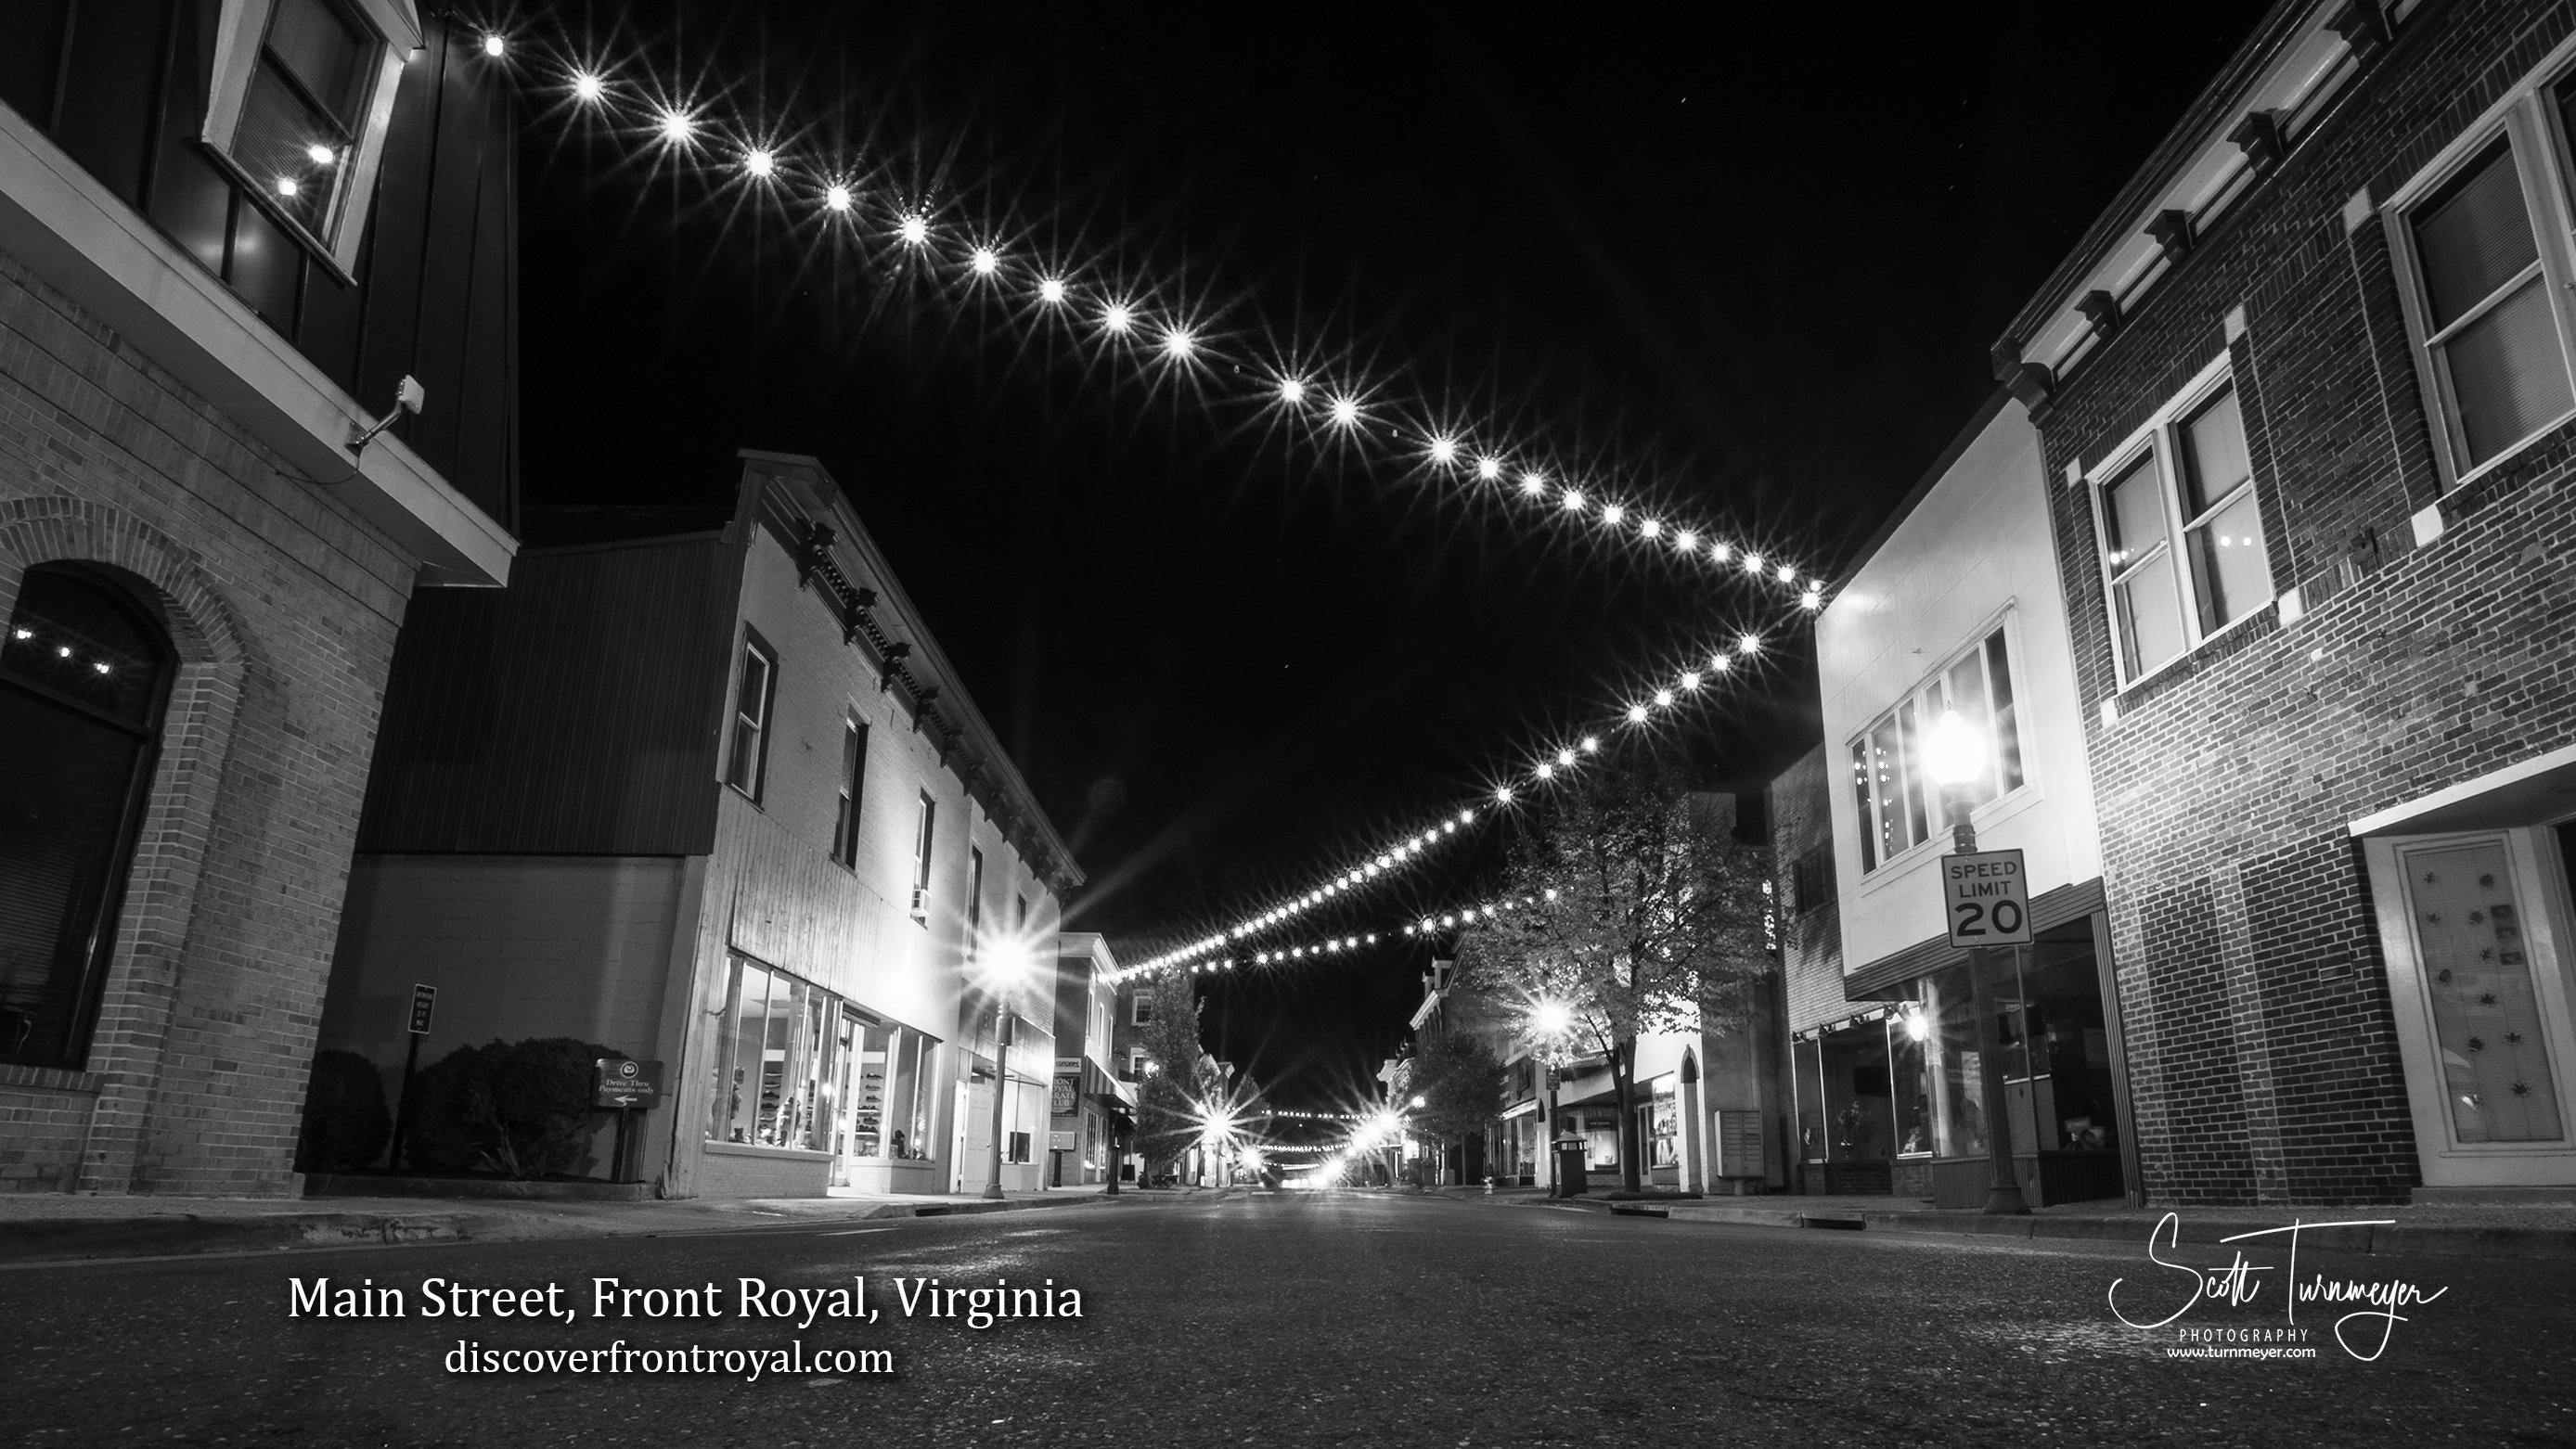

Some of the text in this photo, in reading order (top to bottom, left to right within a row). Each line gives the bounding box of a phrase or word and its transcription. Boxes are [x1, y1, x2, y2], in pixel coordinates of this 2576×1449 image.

[1951, 861, 2017, 879] SPEED
[1959, 880, 2011, 898] LIMIT
[1954, 899, 2023, 937] 20
[599, 1085, 637, 1094] Payments
